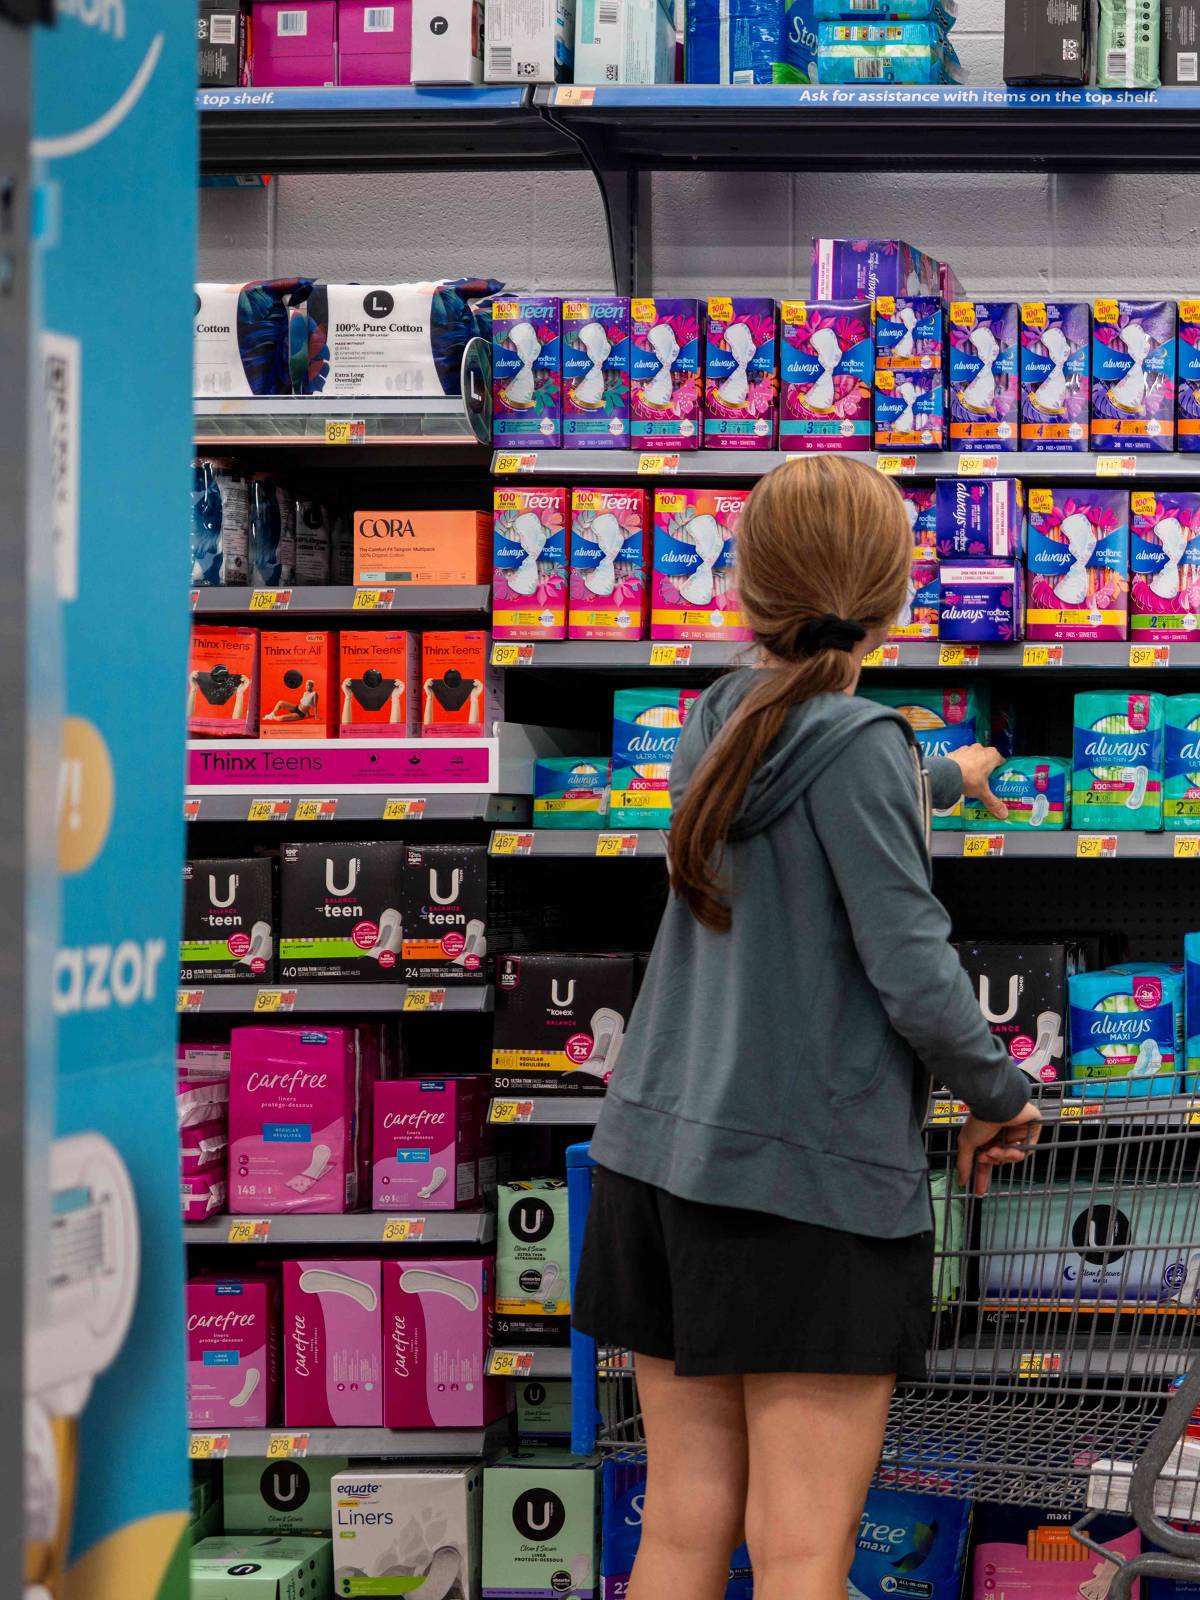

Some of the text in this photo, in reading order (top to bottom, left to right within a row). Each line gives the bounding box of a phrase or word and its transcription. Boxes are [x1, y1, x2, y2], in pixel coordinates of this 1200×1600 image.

[203, 92, 274, 107] top shelf.
[800, 90, 1158, 106] Ask for assistance with items on the top shelf.
[520, 306, 556, 319] Teen
[196, 324, 230, 333] Cotton
[335, 324, 423, 332] 100% Pure Cotton
[496, 360, 521, 369] always
[787, 361, 819, 372] always
[524, 494, 561, 509] Teen
[601, 494, 638, 509] Teen
[360, 519, 416, 538] CORA
[661, 553, 698, 566] always
[1136, 550, 1165, 561] always
[942, 606, 987, 623] always
[192, 639, 250, 650] Thinx Teens
[342, 646, 401, 655] Thinx Teens
[424, 646, 480, 655] Thinx Teens
[265, 646, 321, 656] Thinx for All
[1085, 737, 1148, 761] always
[200, 752, 322, 770] Thinx Teens
[326, 858, 356, 896] U
[209, 874, 236, 907] U
[430, 868, 459, 905] U
[325, 905, 363, 917] teen
[209, 915, 242, 926] teen
[429, 912, 465, 925] teen
[180, 970, 192, 979] 28
[283, 967, 296, 977] 40
[405, 968, 418, 977] 24
[552, 979, 574, 1007] U
[1090, 1015, 1151, 1039] always
[494, 1078, 509, 1087] 50
[496, 1322, 509, 1332] 36
[337, 1483, 378, 1497] equate
[338, 1509, 393, 1526] Liners
[1046, 1512, 1071, 1521] maxi
[860, 1541, 890, 1552] maxi
